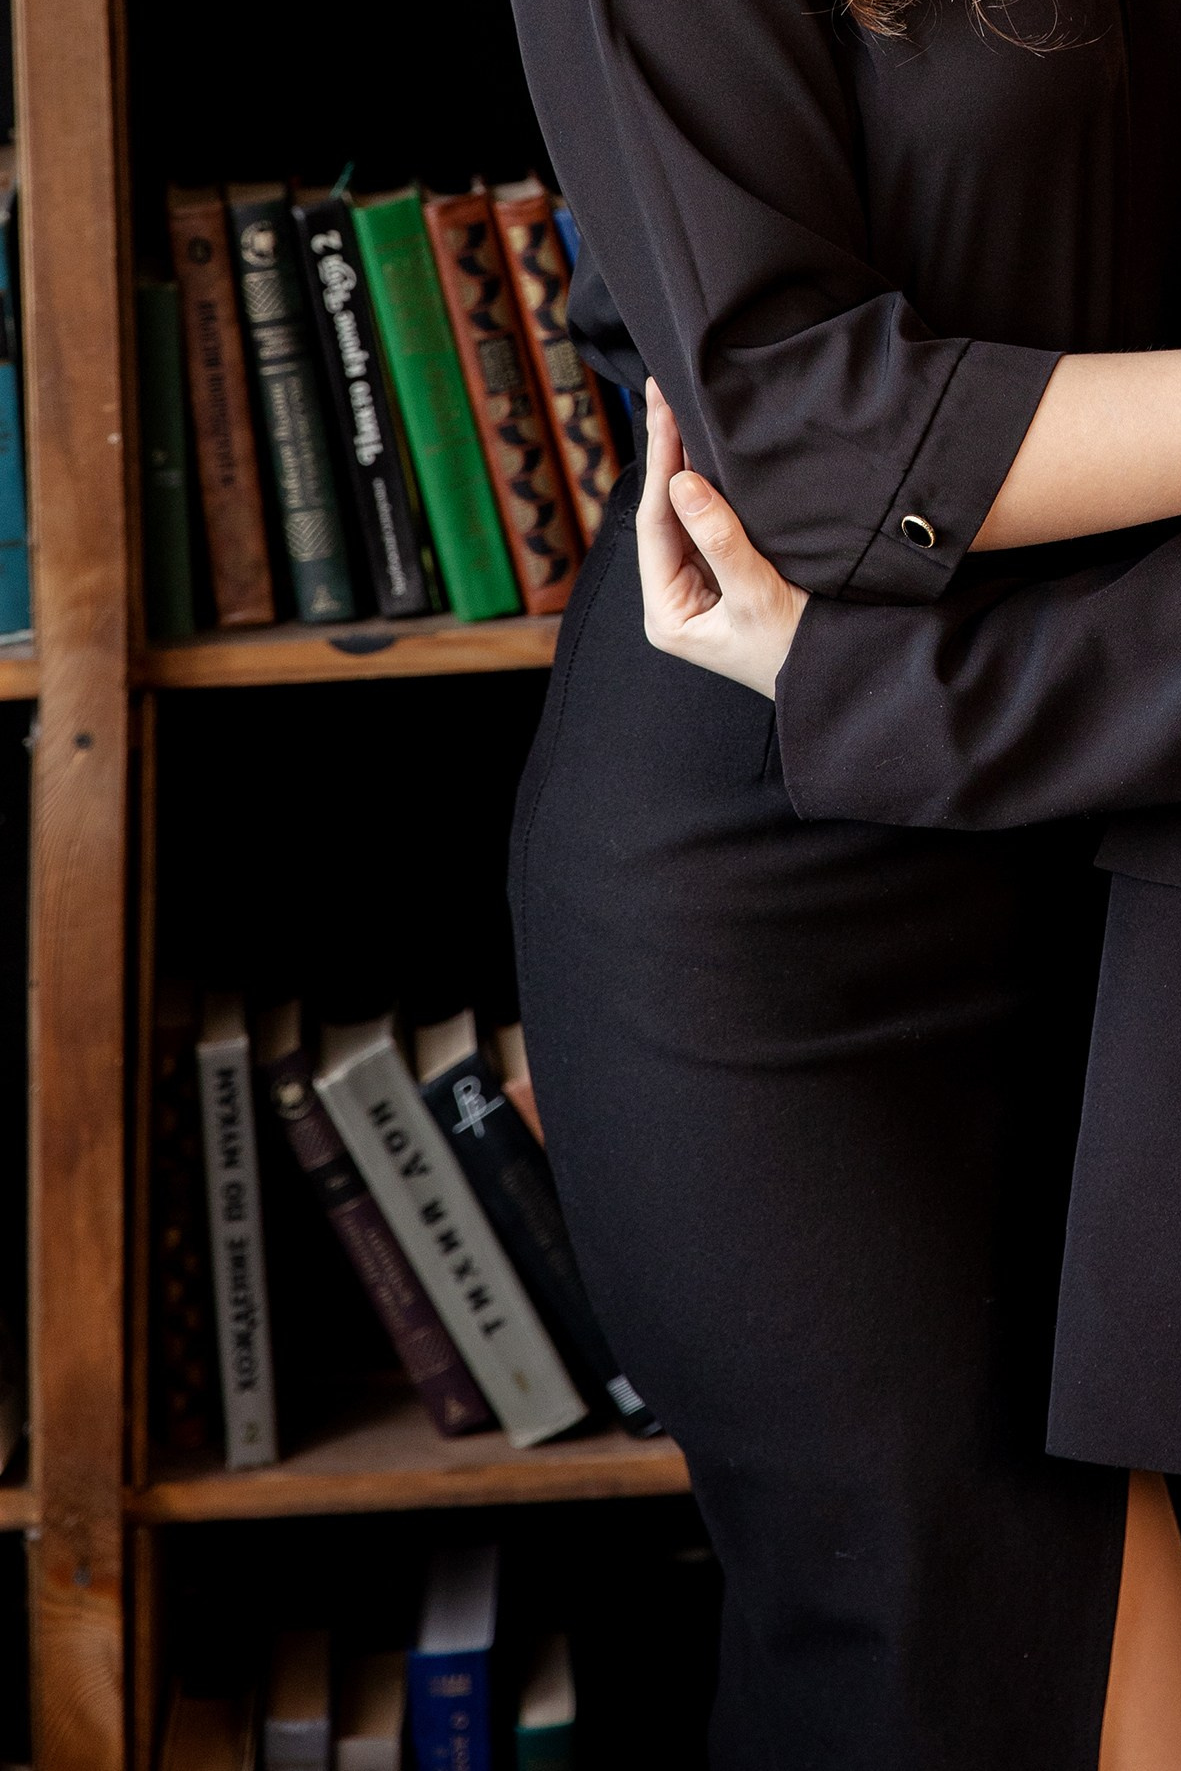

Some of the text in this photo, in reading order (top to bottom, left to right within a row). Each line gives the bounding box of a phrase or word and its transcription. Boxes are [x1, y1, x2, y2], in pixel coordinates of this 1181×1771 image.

[370, 1100, 431, 1183] ДОН
[216, 1067, 259, 1393] ХОЖДЕНИЕ ПО МУКАМ
[421, 1200, 506, 1339] ТИХИЙ
